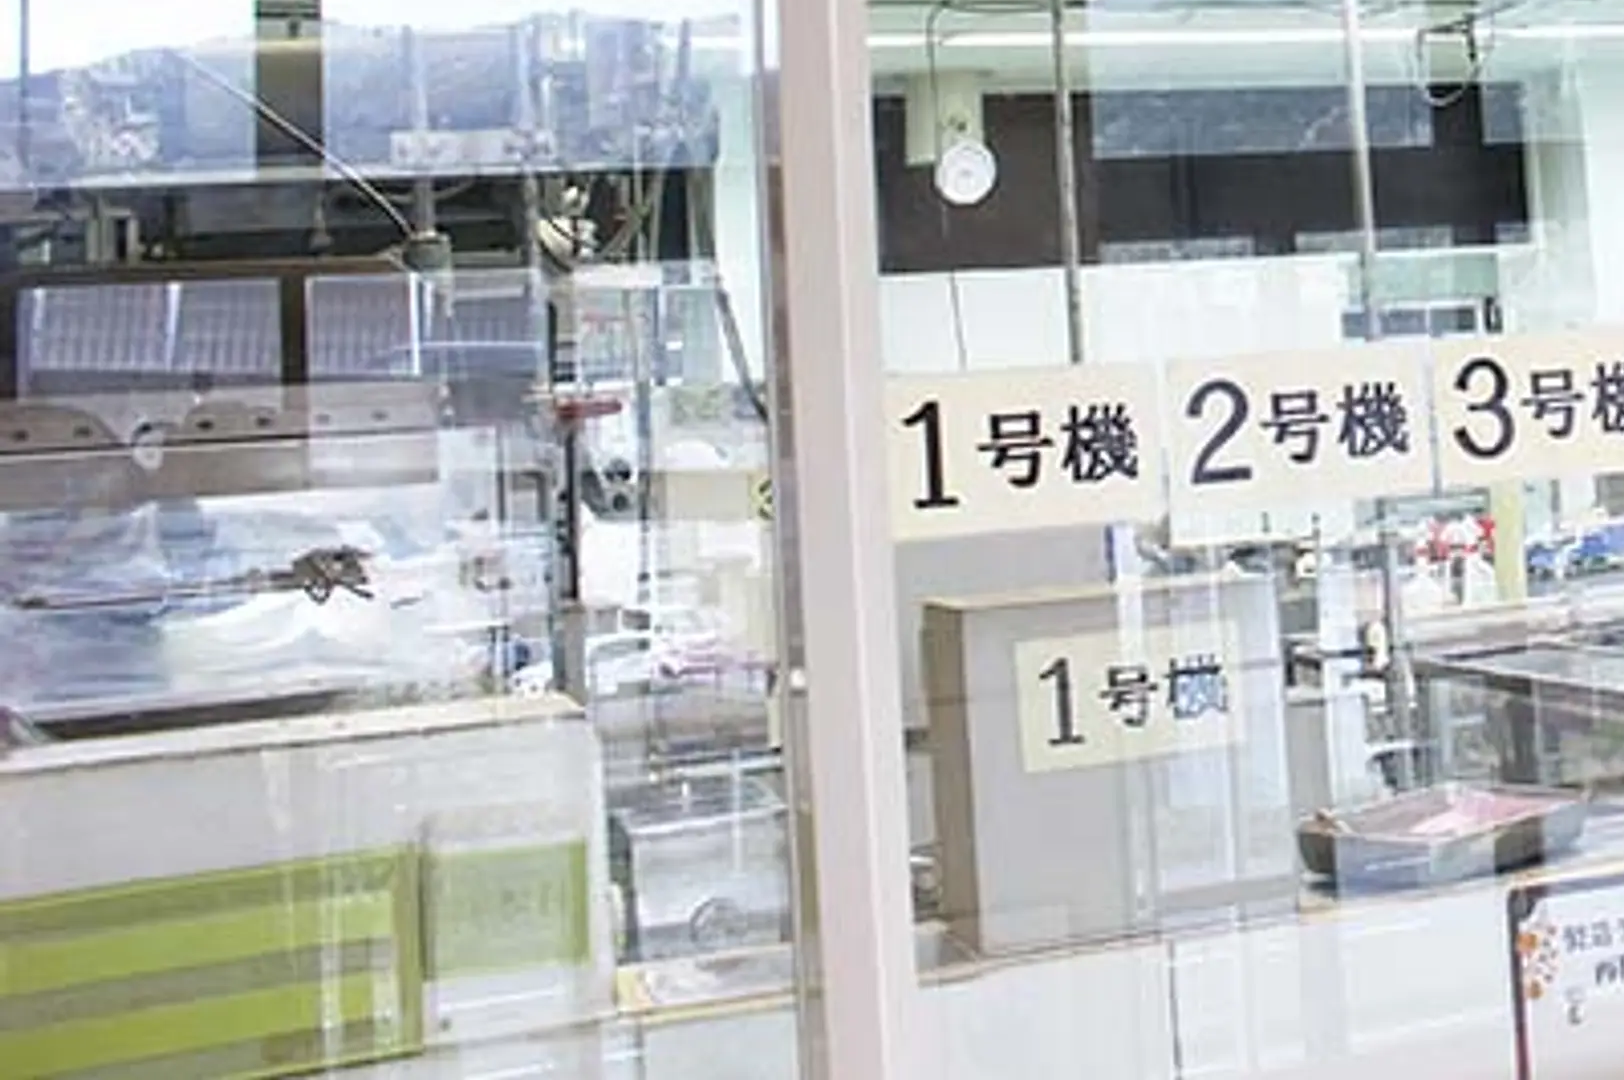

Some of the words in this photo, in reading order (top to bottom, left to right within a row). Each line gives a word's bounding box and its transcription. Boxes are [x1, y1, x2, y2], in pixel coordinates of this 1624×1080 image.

[901, 400, 1139, 510] 1号機
[1185, 379, 1410, 485] 2号機
[1039, 657, 1228, 746] 1号機
